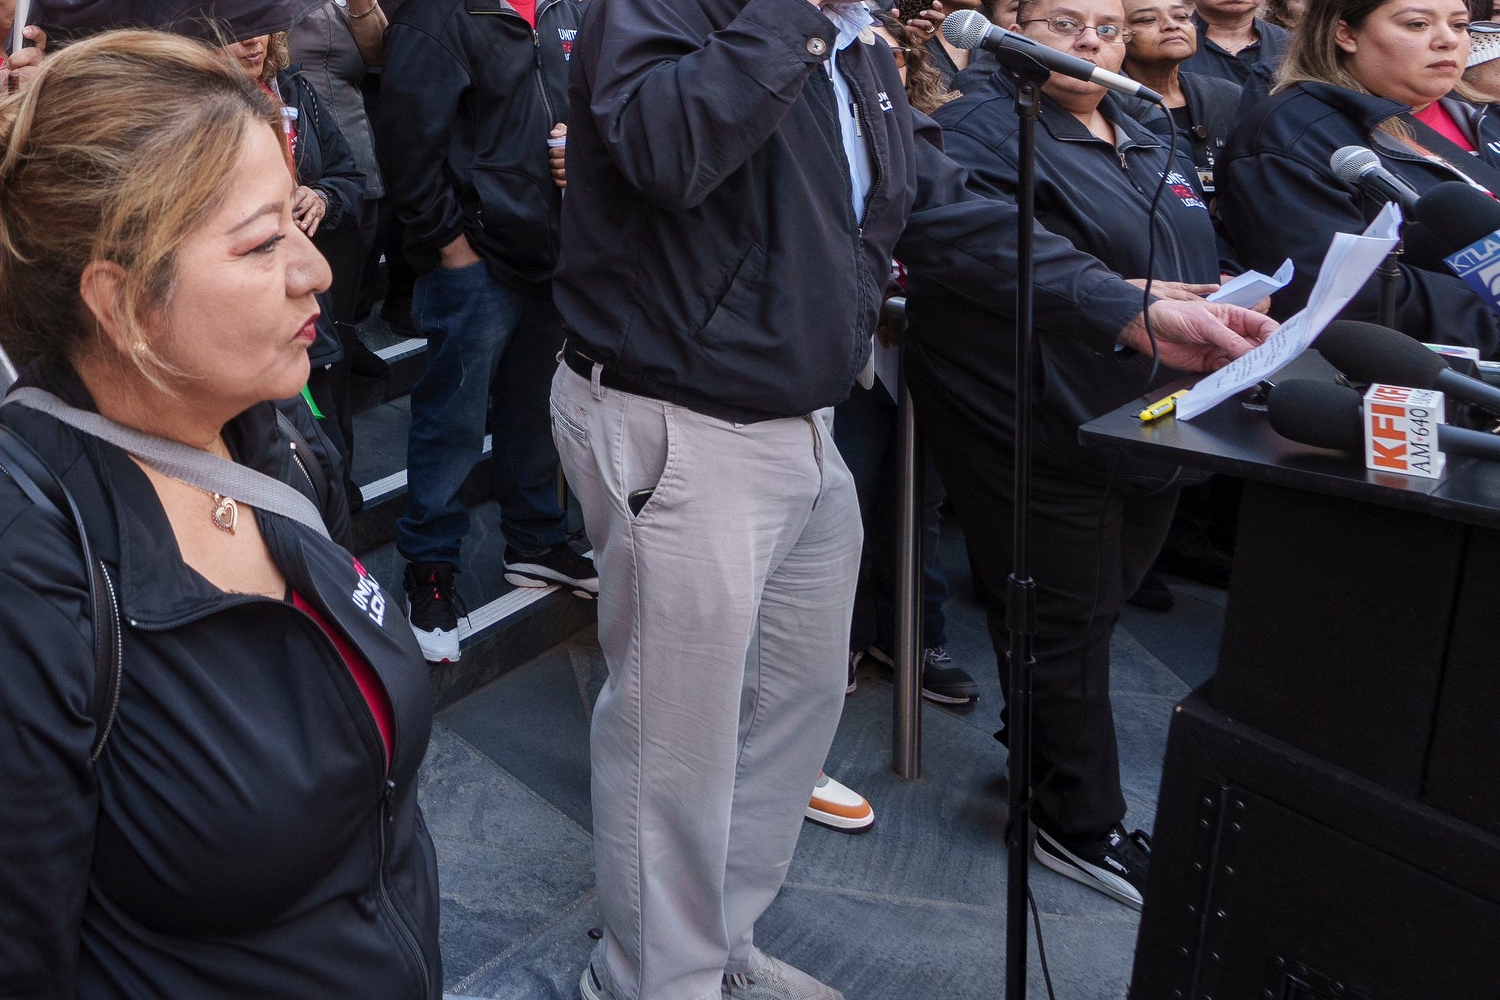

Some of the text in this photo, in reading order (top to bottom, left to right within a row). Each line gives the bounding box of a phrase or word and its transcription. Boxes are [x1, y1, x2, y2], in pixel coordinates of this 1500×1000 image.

[557, 28, 578, 41] UNIT
[1447, 238, 1500, 273] KTLA
[1371, 403, 1408, 471] KFI
[1409, 407, 1430, 437] 640
[1410, 441, 1432, 474] AM
